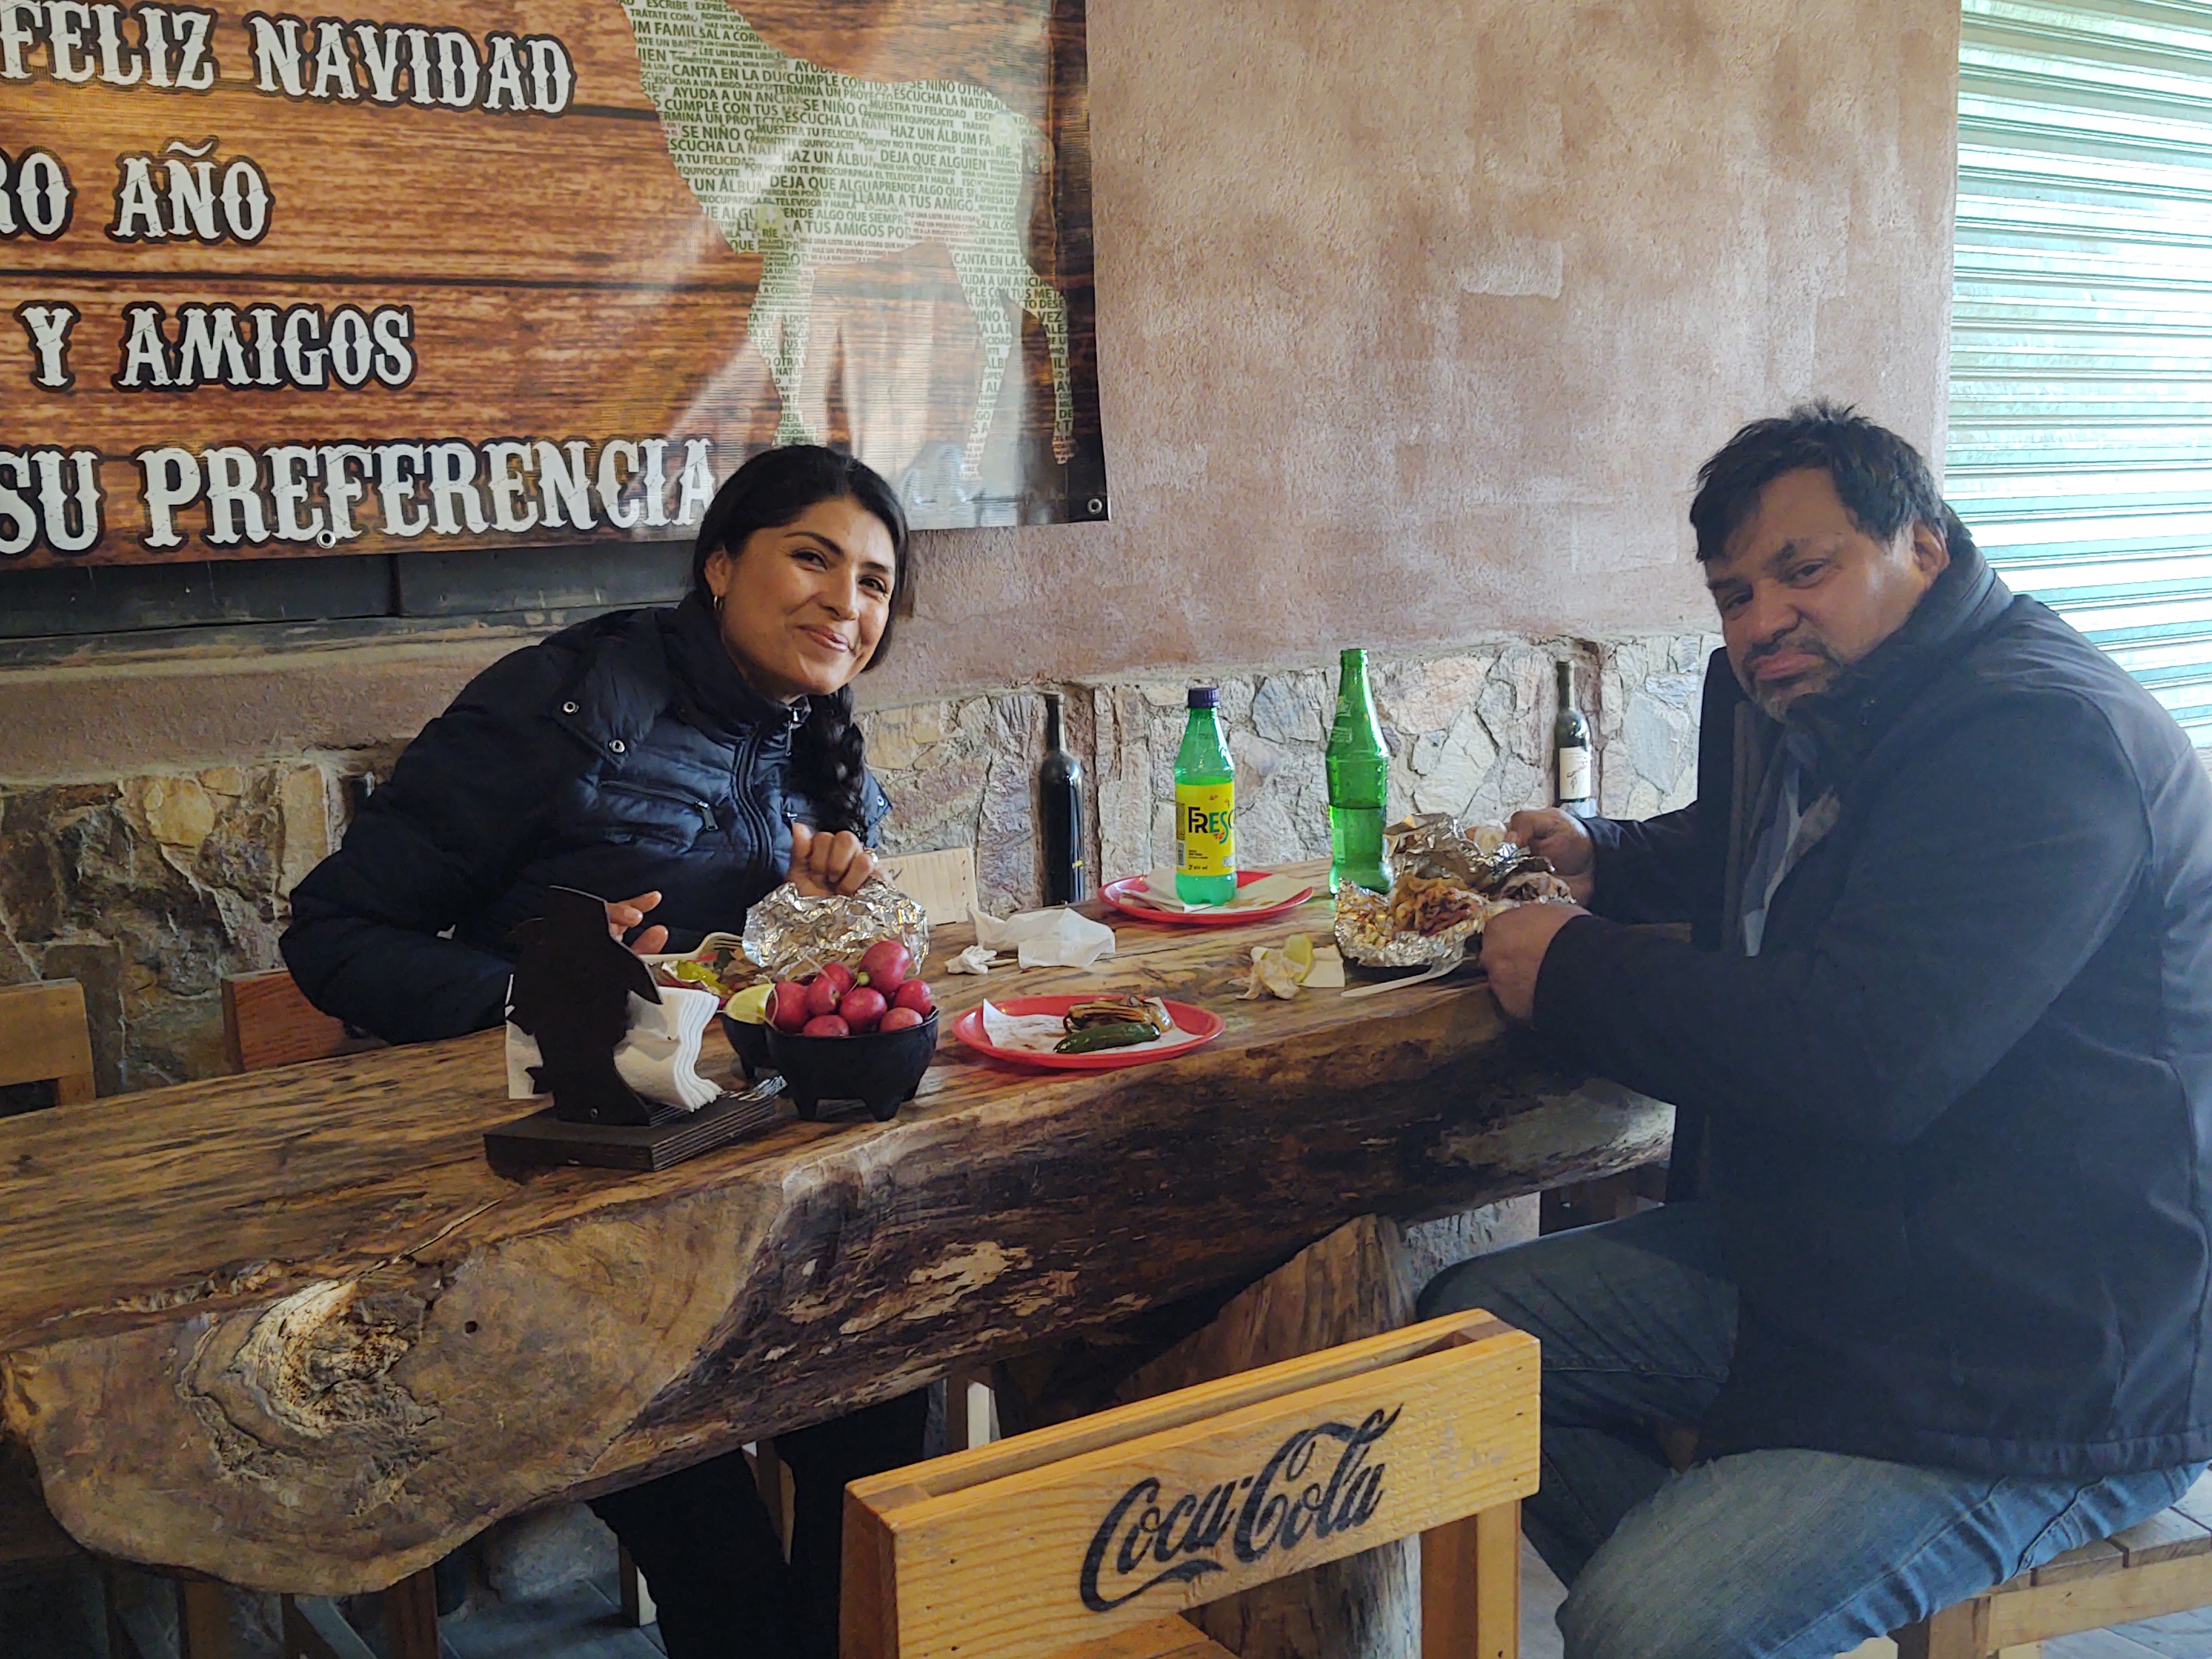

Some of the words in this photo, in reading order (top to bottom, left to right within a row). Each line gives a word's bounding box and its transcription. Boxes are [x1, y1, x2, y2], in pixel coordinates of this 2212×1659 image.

[630, 8, 668, 19] TRÁTATE
[700, 27, 720, 39] SAL
[723, 30, 731, 40] A
[1, 0, 213, 90] FELIZ
[248, 17, 572, 112] NAVIDAD
[700, 47, 713, 56] LEE
[672, 64, 717, 79] CANTA
[722, 67, 739, 80] EN
[742, 69, 759, 81] LA
[787, 72, 838, 87] CUMPLE
[842, 77, 865, 88] CON
[674, 87, 718, 100] AYUDA
[722, 90, 730, 100] A
[733, 90, 752, 101] UN
[773, 85, 823, 96] TERMINA
[826, 87, 840, 97] UN
[894, 88, 942, 104] ESCUCHA
[946, 94, 957, 106] LA
[665, 99, 719, 113] CUMPLE
[723, 102, 750, 114] CON
[753, 103, 778, 116] TUS
[803, 99, 819, 111] SE
[870, 100, 910, 113] MUESTRA
[912, 105, 922, 114] TU
[925, 106, 966, 118] FELICIDAD
[706, 113, 722, 123] UN
[785, 111, 841, 126] ESCUCHA
[845, 116, 858, 127] LA
[682, 126, 698, 138] SE
[806, 127, 819, 137] TU
[891, 124, 915, 138] HAZ
[918, 128, 934, 140] UN
[728, 142, 744, 153] LA
[686, 154, 700, 164] TU
[814, 151, 832, 164] UN
[881, 150, 909, 164] DEJA
[913, 153, 936, 167] QUE
[940, 155, 986, 170] ALGUIEN
[695, 179, 714, 191] UN
[770, 175, 805, 189] DEJA
[809, 176, 836, 191] QUE
[873, 181, 916, 194] APRENDE
[919, 184, 943, 195] ALGO
[946, 186, 964, 197] QUE
[114, 140, 269, 241] AÑO
[899, 195, 906, 207] A
[909, 195, 931, 208] TUS
[817, 209, 843, 220] ALGO
[847, 211, 867, 222] QUE
[794, 220, 801, 232] A
[805, 221, 831, 234] TUS
[834, 222, 884, 238] AMIGOS
[954, 253, 987, 265] CANTA
[990, 255, 1002, 265] EN
[1005, 255, 1017, 267] LA
[988, 275, 995, 286] A
[997, 276, 1011, 286] UN
[1039, 311, 1062, 322] VEZ
[22, 306, 77, 388] Y
[118, 306, 414, 388] AMIGOS
[137, 439, 717, 546] PREFERENCIA
